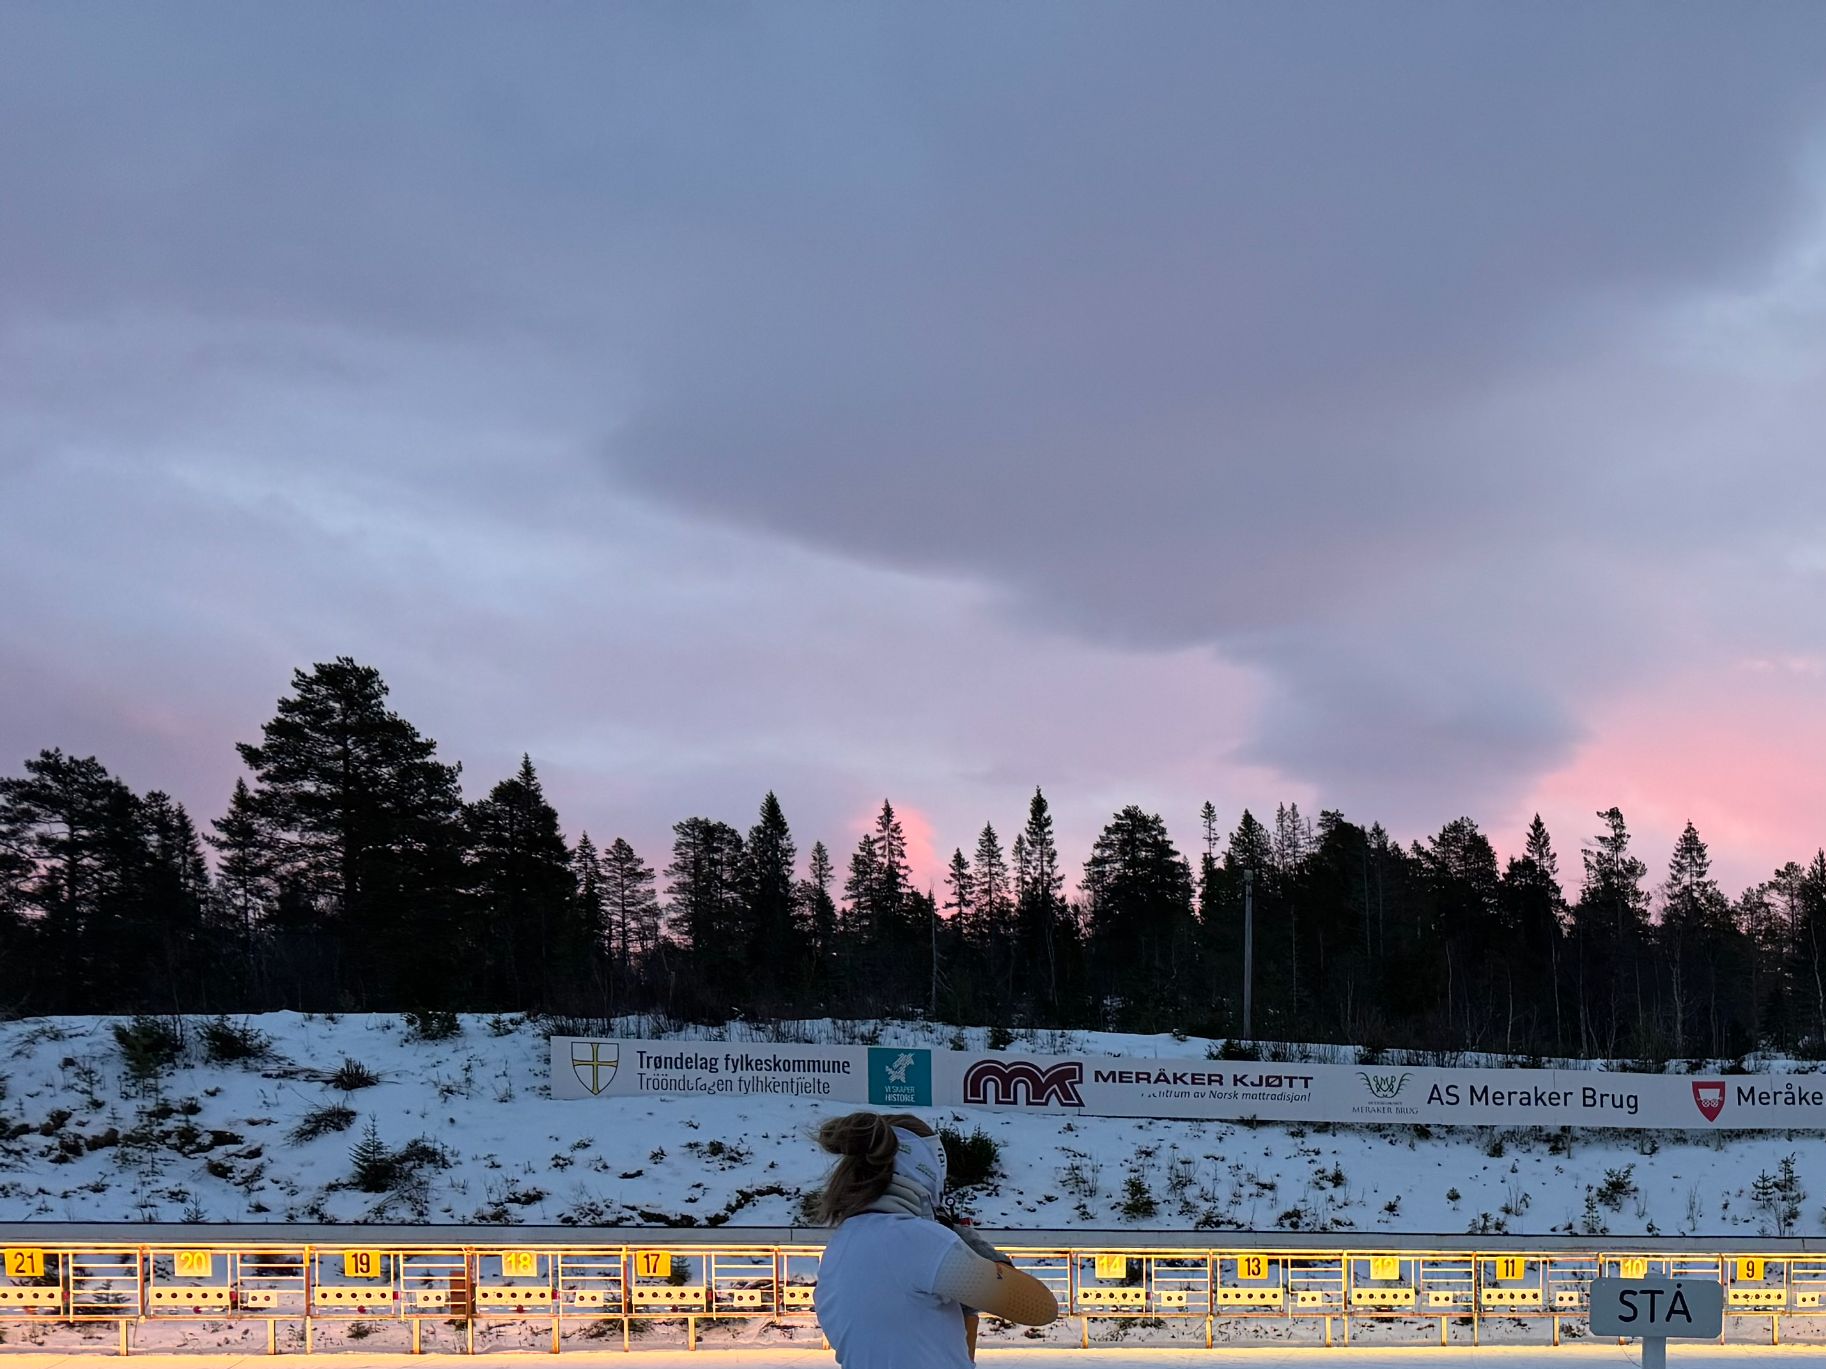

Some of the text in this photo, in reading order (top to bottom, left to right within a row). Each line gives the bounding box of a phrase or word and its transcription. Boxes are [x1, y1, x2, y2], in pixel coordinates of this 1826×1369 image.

[636, 1050, 851, 1075] Trøndelag fylkeskommune
[1094, 1068, 1314, 1089] MERÅKER KJØTT
[1193, 1091, 1207, 1099] av
[1208, 1090, 1239, 1100] Norsk
[1427, 1083, 1639, 1115] AS Meraker Brug
[14, 1252, 36, 1274] 21
[180, 1251, 207, 1273] 20
[351, 1253, 371, 1274] 19
[506, 1252, 533, 1274] 18
[643, 1253, 661, 1274] 17
[1244, 1257, 1261, 1276] 13
[1503, 1258, 1516, 1278] 11
[1623, 1259, 1645, 1276] 10
[1745, 1260, 1755, 1278] 9
[1617, 1282, 1693, 1323] STÅ
